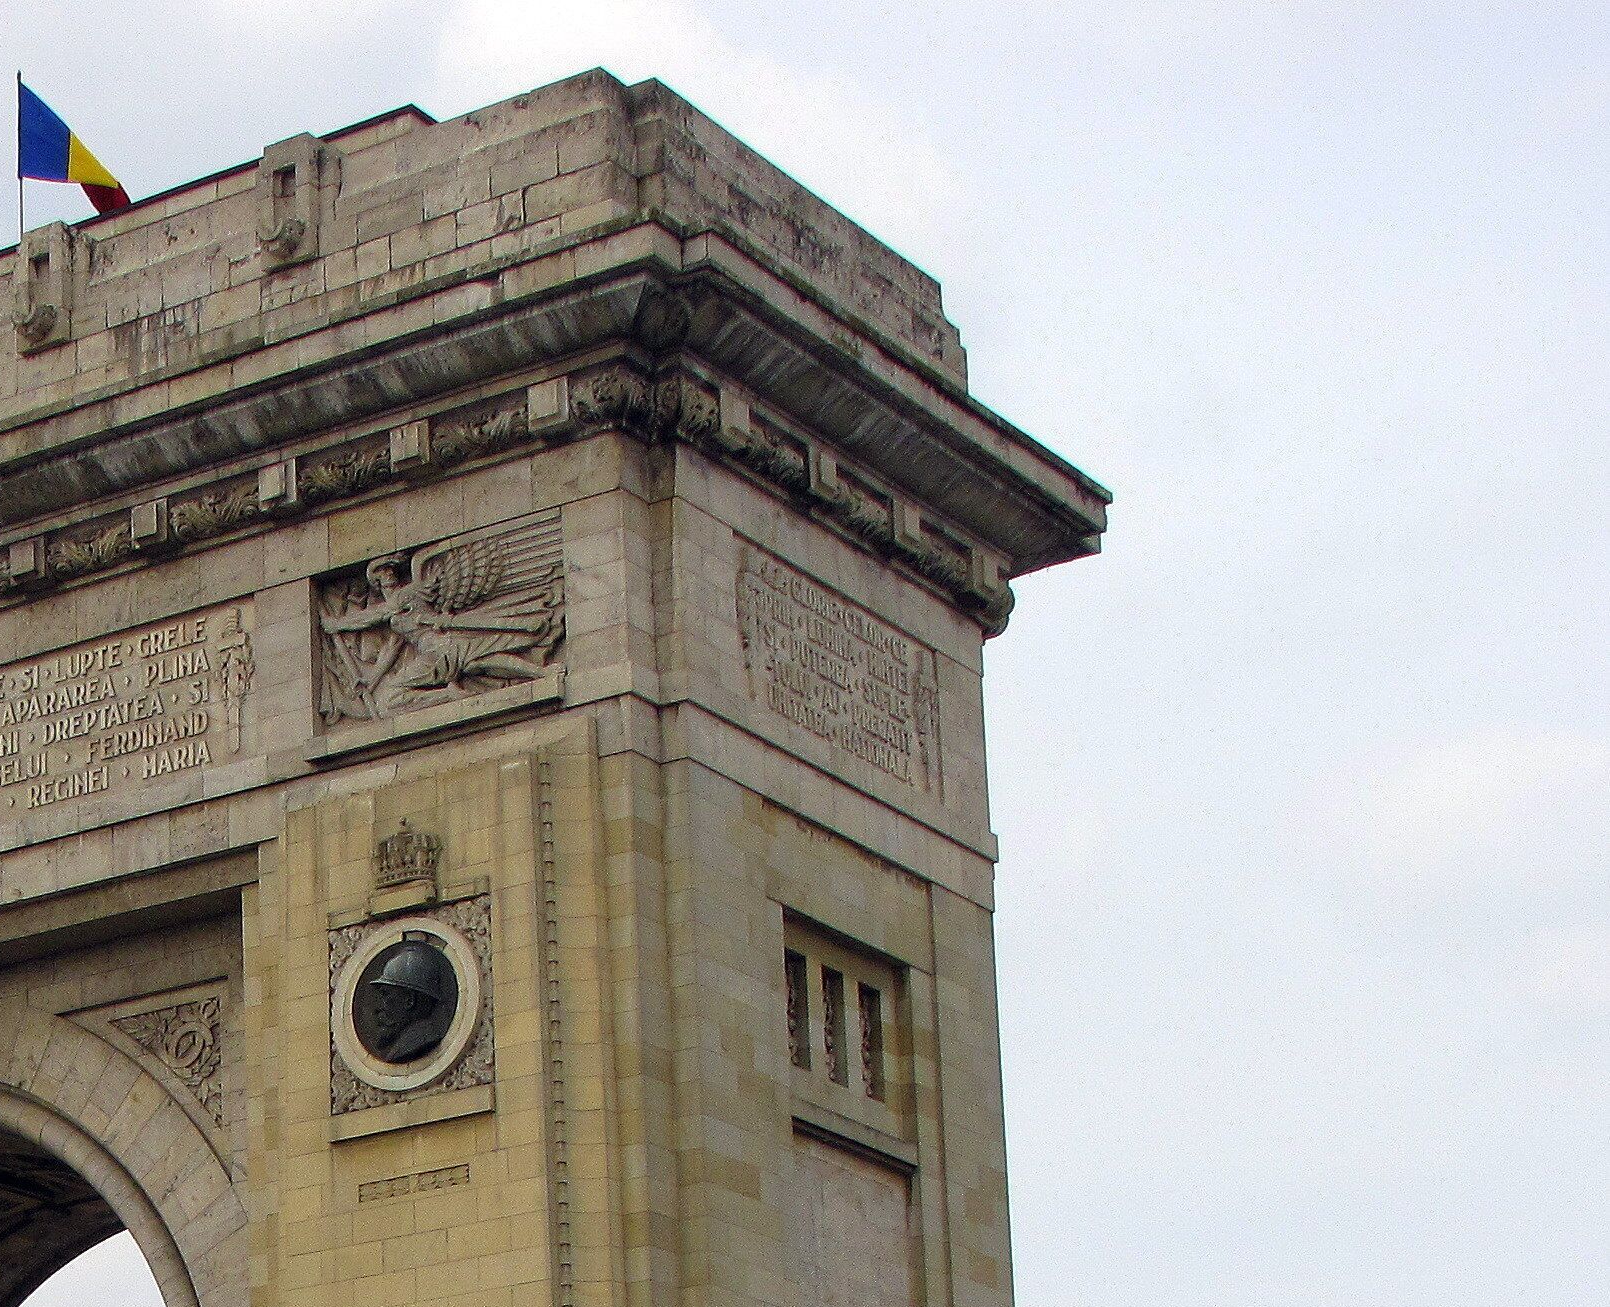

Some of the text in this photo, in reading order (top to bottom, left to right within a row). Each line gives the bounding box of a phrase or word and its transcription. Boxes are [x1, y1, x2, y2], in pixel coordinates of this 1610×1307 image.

[1, 675, 116, 727] APARAREA
[145, 648, 211, 687] PLINA
[22, 666, 40, 692] SI
[55, 643, 122, 683] LUPTE
[138, 618, 208, 658] GRELE
[43, 690, 165, 746] DREPTATEA
[189, 679, 210, 704] SI
[86, 710, 210, 764] FERDINAND
[27, 766, 110, 808] REGINEI
[143, 741, 212, 779] MARIA
